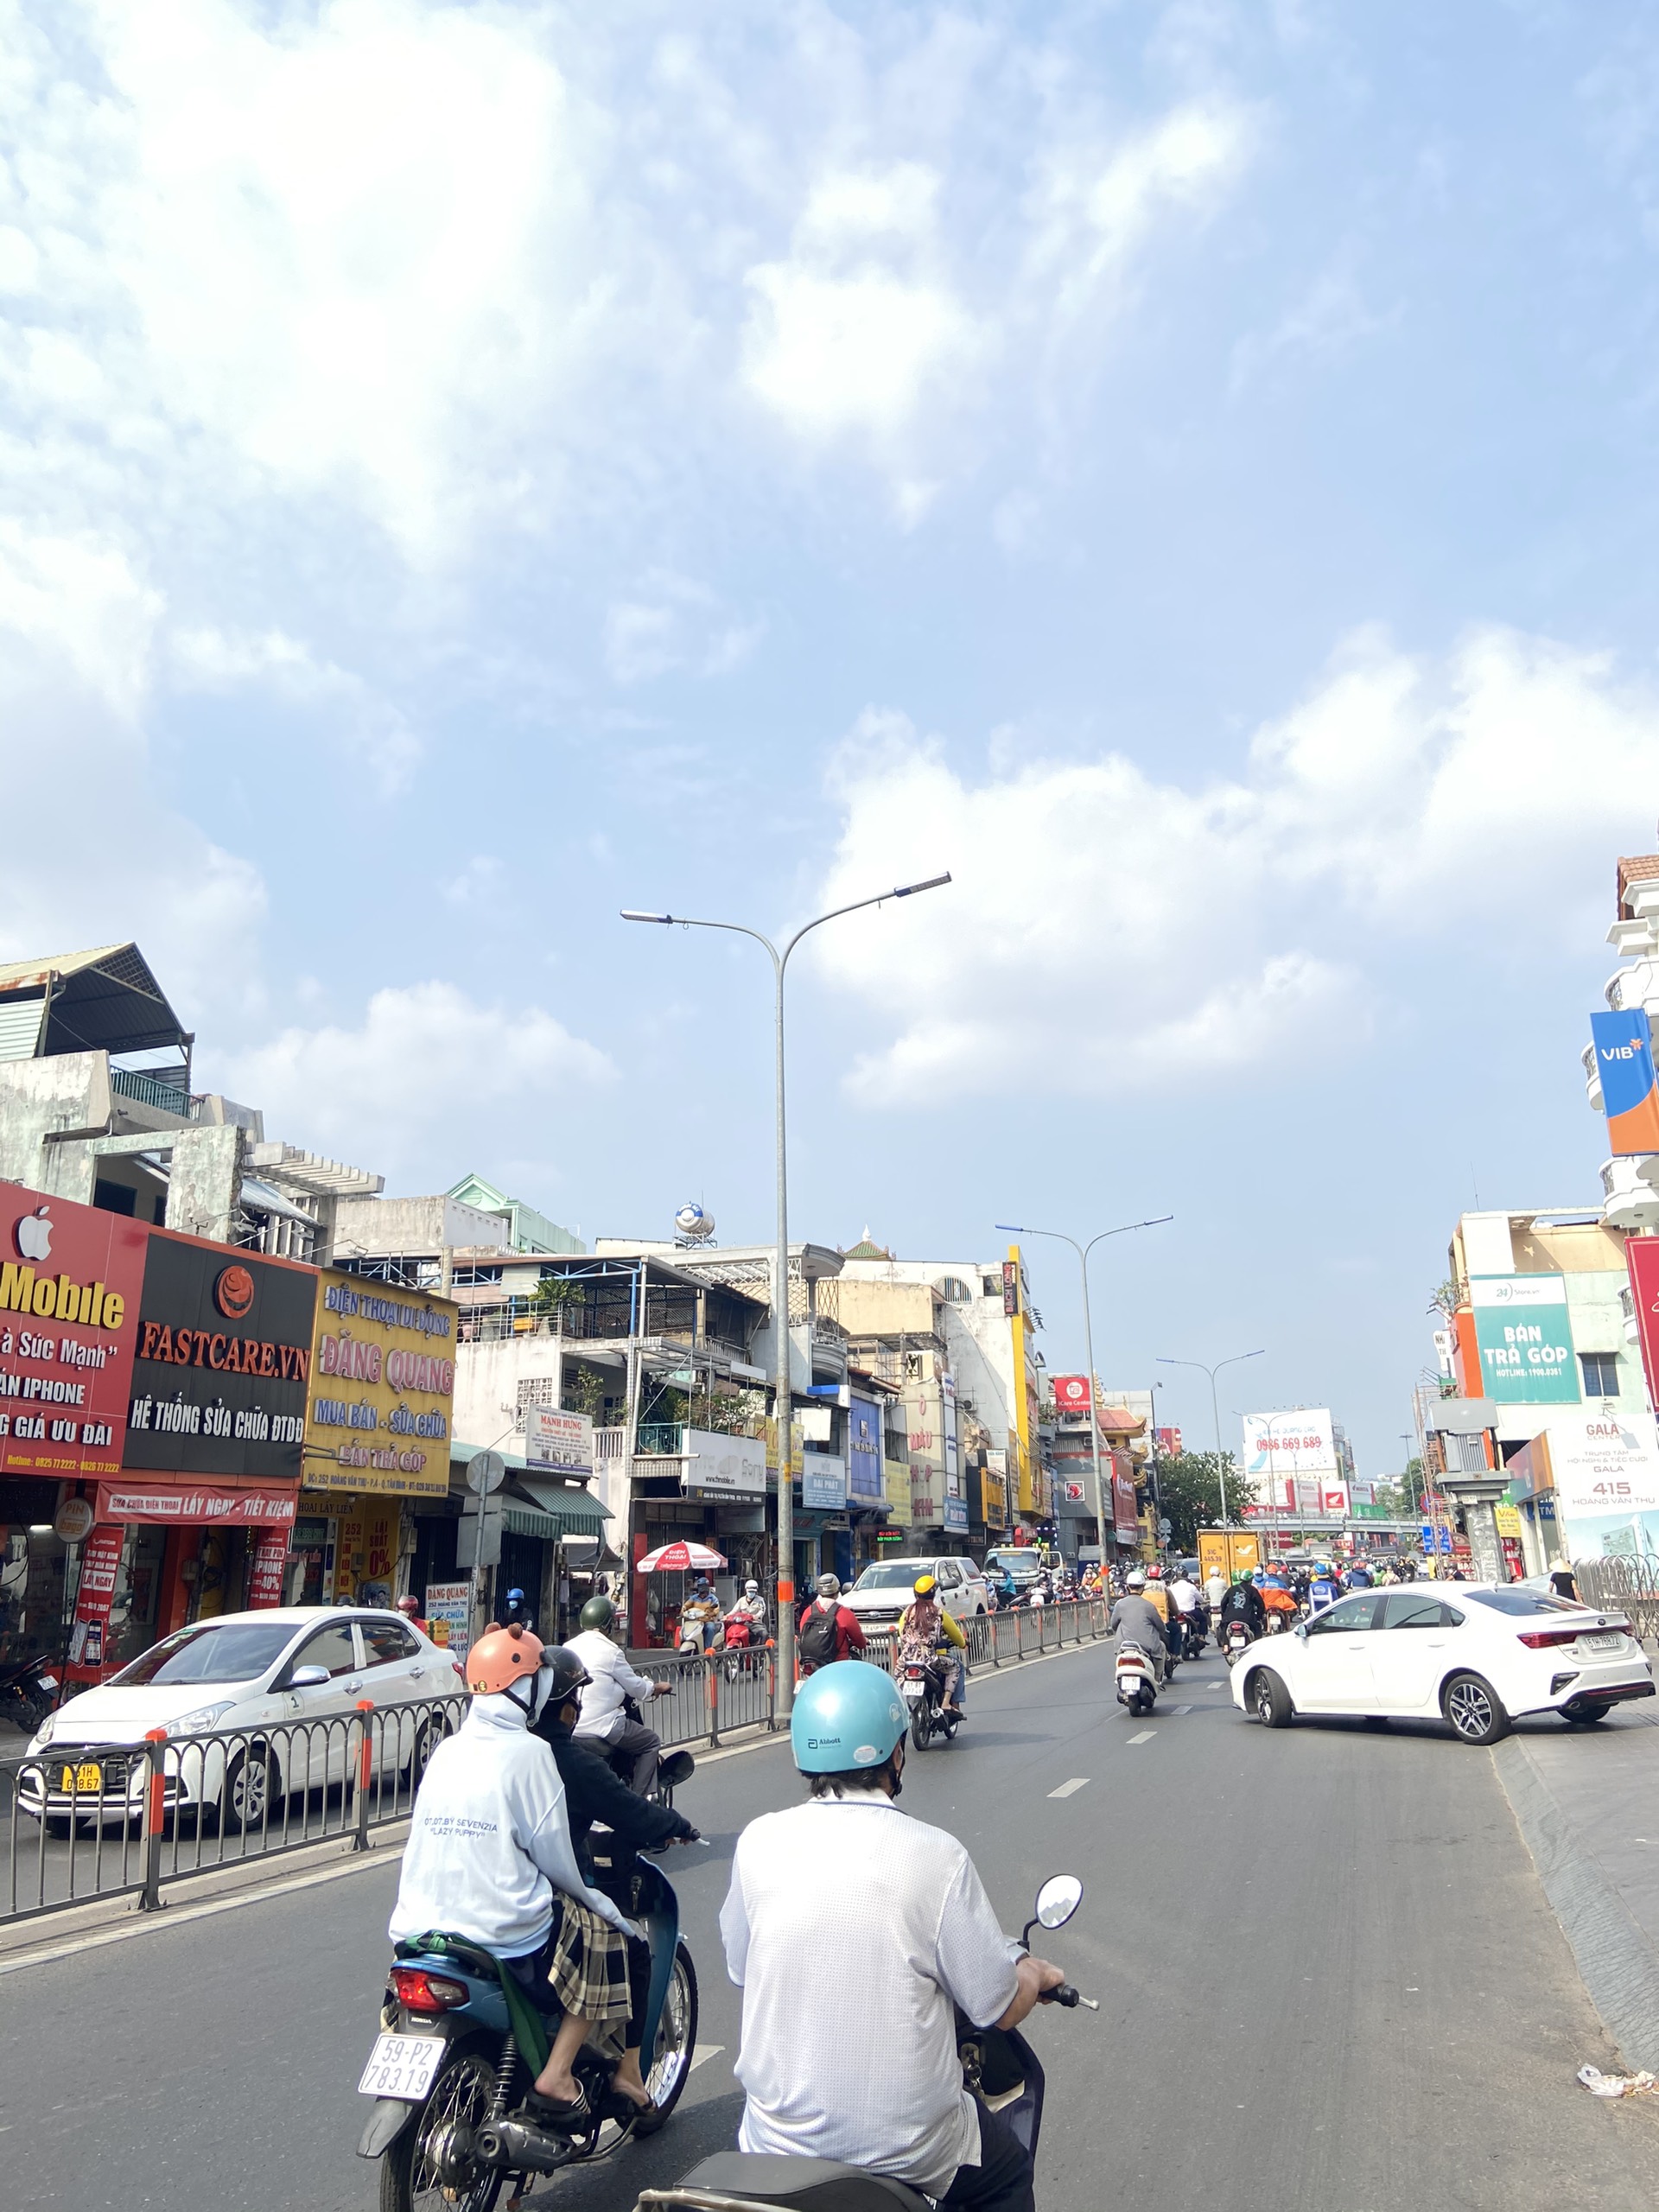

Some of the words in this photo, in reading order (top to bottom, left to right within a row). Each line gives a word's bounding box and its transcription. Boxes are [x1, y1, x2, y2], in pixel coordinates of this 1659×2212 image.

[1601, 1046, 1634, 1061] VIB
[361, 1295, 400, 1331] THOẠI
[400, 1304, 416, 1326] DI
[1503, 1322, 1541, 1343] BÁN
[19, 1332, 55, 1361] Sức
[140, 1320, 312, 1382] FASTCARE.VN
[1484, 1343, 1521, 1364] TRẢ
[1527, 1344, 1568, 1363] GÓP
[386, 1349, 454, 1395] QUANG
[1496, 1368, 1528, 1377] HOTLINE:
[22, 1376, 86, 1405] IPHONE
[154, 1391, 200, 1434] THỐNG
[203, 1397, 232, 1438] SỬA
[234, 1405, 270, 1441] CHỮA
[314, 1399, 346, 1427] MUA
[347, 1398, 378, 1431] BÁN
[389, 1402, 415, 1436] SỬA
[415, 1408, 447, 1439] CHỮA
[541, 1414, 562, 1428] MẠNH
[15, 1412, 46, 1440] GIÁ
[51, 1418, 78, 1442] ƯU
[1586, 1423, 1619, 1435] GALA
[1256, 1438, 1279, 1452] 0986
[1282, 1437, 1300, 1450] 669
[1303, 1435, 1322, 1448] 689
[339, 1438, 370, 1467] BÁN
[372, 1442, 398, 1471] TRẢ
[399, 1446, 427, 1472] GÓP
[1593, 1465, 1624, 1473] GALA
[318, 1473, 329, 1484] 252
[1592, 1481, 1631, 1495] 415
[66, 1503, 85, 1515] PIN
[183, 1491, 204, 1516] LẤY
[205, 1497, 235, 1516] NGAY
[244, 1493, 265, 1517] TIẾT
[265, 1497, 295, 1520] KIỆM
[1533, 1506, 1554, 1516] TM
[346, 1523, 361, 1535] 252
[255, 1560, 283, 1574] IPHONE
[370, 1548, 391, 1576] 0%
[94, 1574, 112, 1588] NGAY
[261, 1575, 279, 1590] 40%
[446, 1586, 467, 1600] QUANG
[446, 1609, 465, 1619] CHỮA
[77, 1766, 93, 1777] 1H
[67, 1778, 99, 1789] 08.67
[456, 1818, 498, 1832] SEVENZIA
[382, 2039, 433, 2066] 59-P2
[365, 2065, 429, 2093] 783.19
